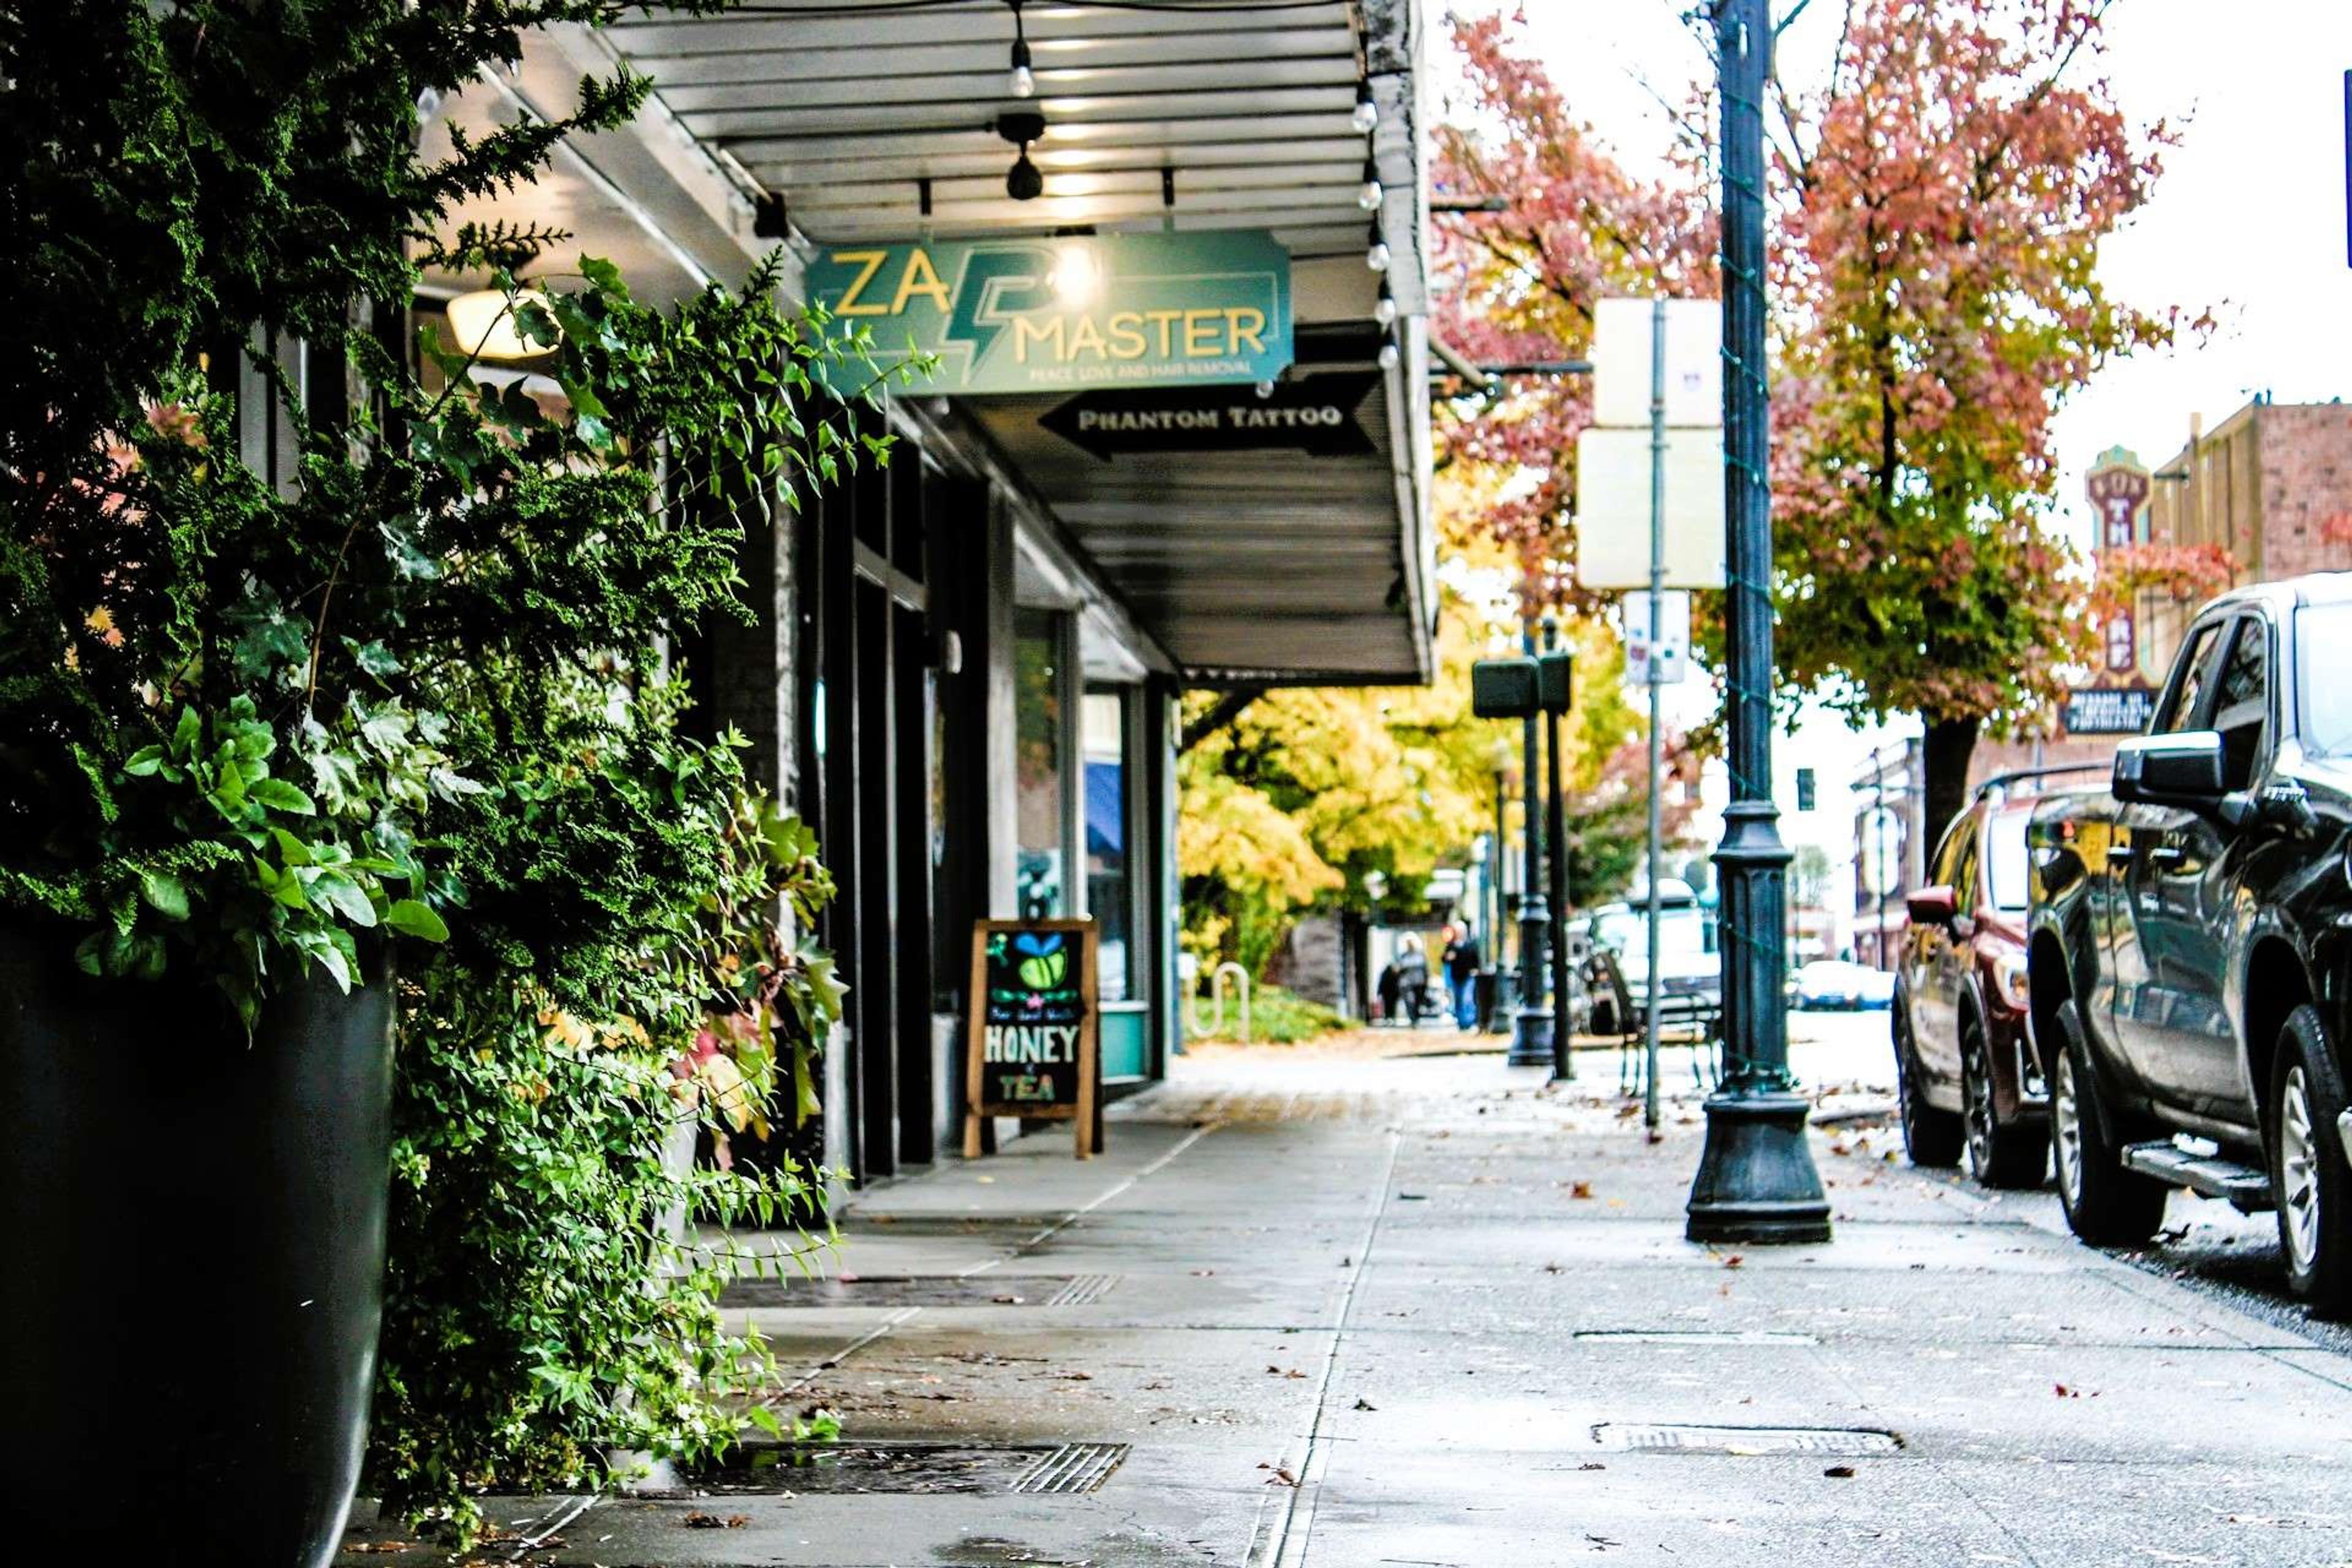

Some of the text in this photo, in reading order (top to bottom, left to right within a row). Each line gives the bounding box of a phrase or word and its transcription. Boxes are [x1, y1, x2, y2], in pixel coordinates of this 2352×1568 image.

[1012, 308, 1267, 364] MASTER
[1117, 366, 1149, 379] AND
[984, 1025, 1079, 1064] HONEY
[999, 1074, 1055, 1100] TEA
